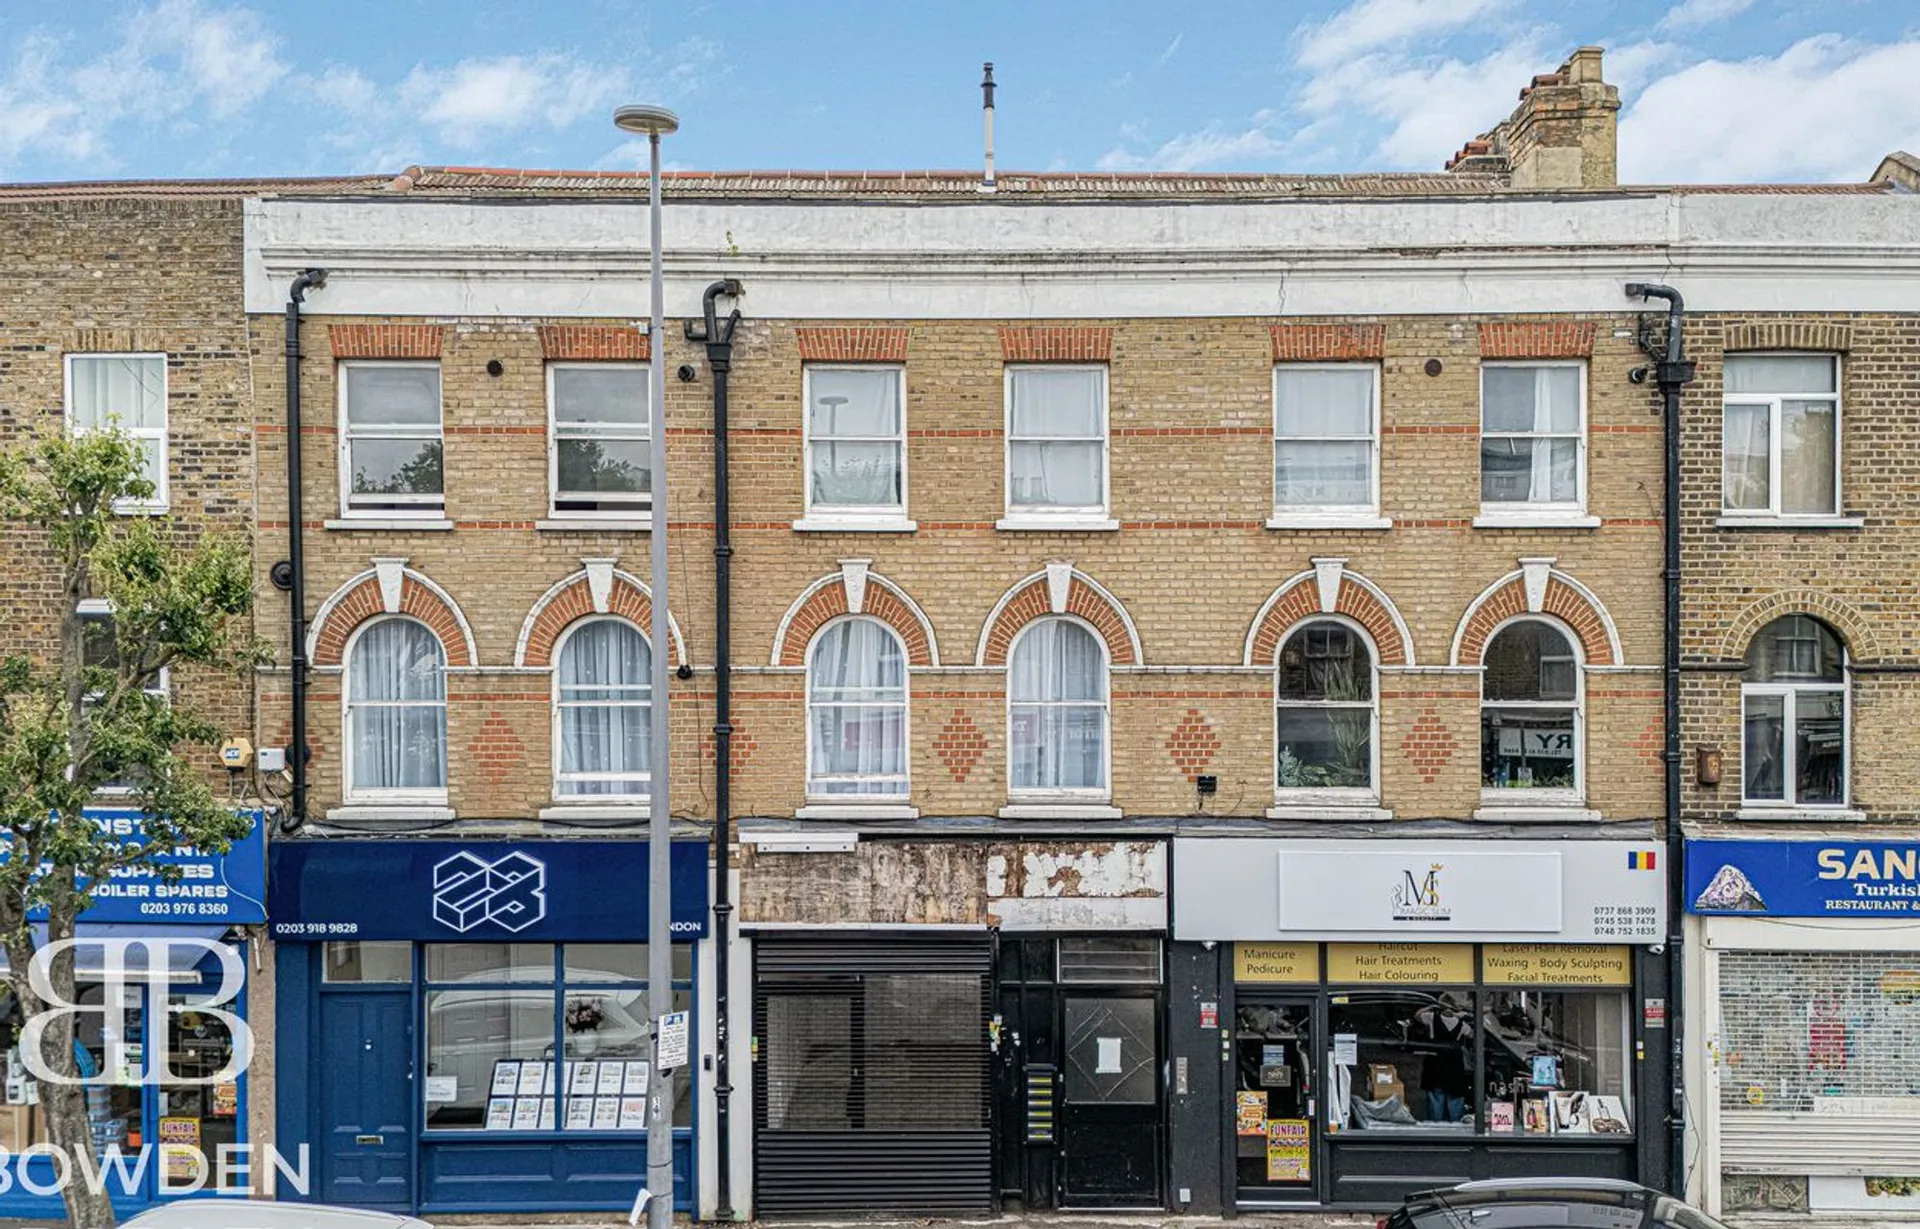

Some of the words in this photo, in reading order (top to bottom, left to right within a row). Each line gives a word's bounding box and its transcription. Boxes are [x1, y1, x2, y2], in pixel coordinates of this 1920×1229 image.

[1817, 849, 1920, 880] SAN
[155, 885, 228, 897] SPARES
[141, 903, 170, 914] 0203
[174, 903, 196, 914] 976
[199, 903, 228, 914] 8360
[1594, 906, 1615, 915] 0737
[1825, 900, 1909, 911] RESTAURANT
[276, 924, 305, 933] 0203
[307, 924, 326, 933] 918
[329, 924, 358, 933] 9828
[670, 922, 702, 931] NDON
[1378, 943, 1418, 951] Haircut
[1244, 949, 1297, 960] Manicure
[1356, 955, 1380, 966] Hair
[1381, 955, 1442, 966] Treatments
[1487, 957, 1529, 970] Waxing
[1540, 957, 1567, 971] Body
[1571, 957, 1623, 971] Sculpting
[1246, 963, 1294, 975] Pedicure
[1359, 970, 1381, 981] Hair
[1385, 970, 1439, 982] Colouring
[1508, 972, 1538, 983] Facial
[1541, 972, 1603, 983] Treatments
[1270, 1124, 1307, 1136] FUNFAIR
